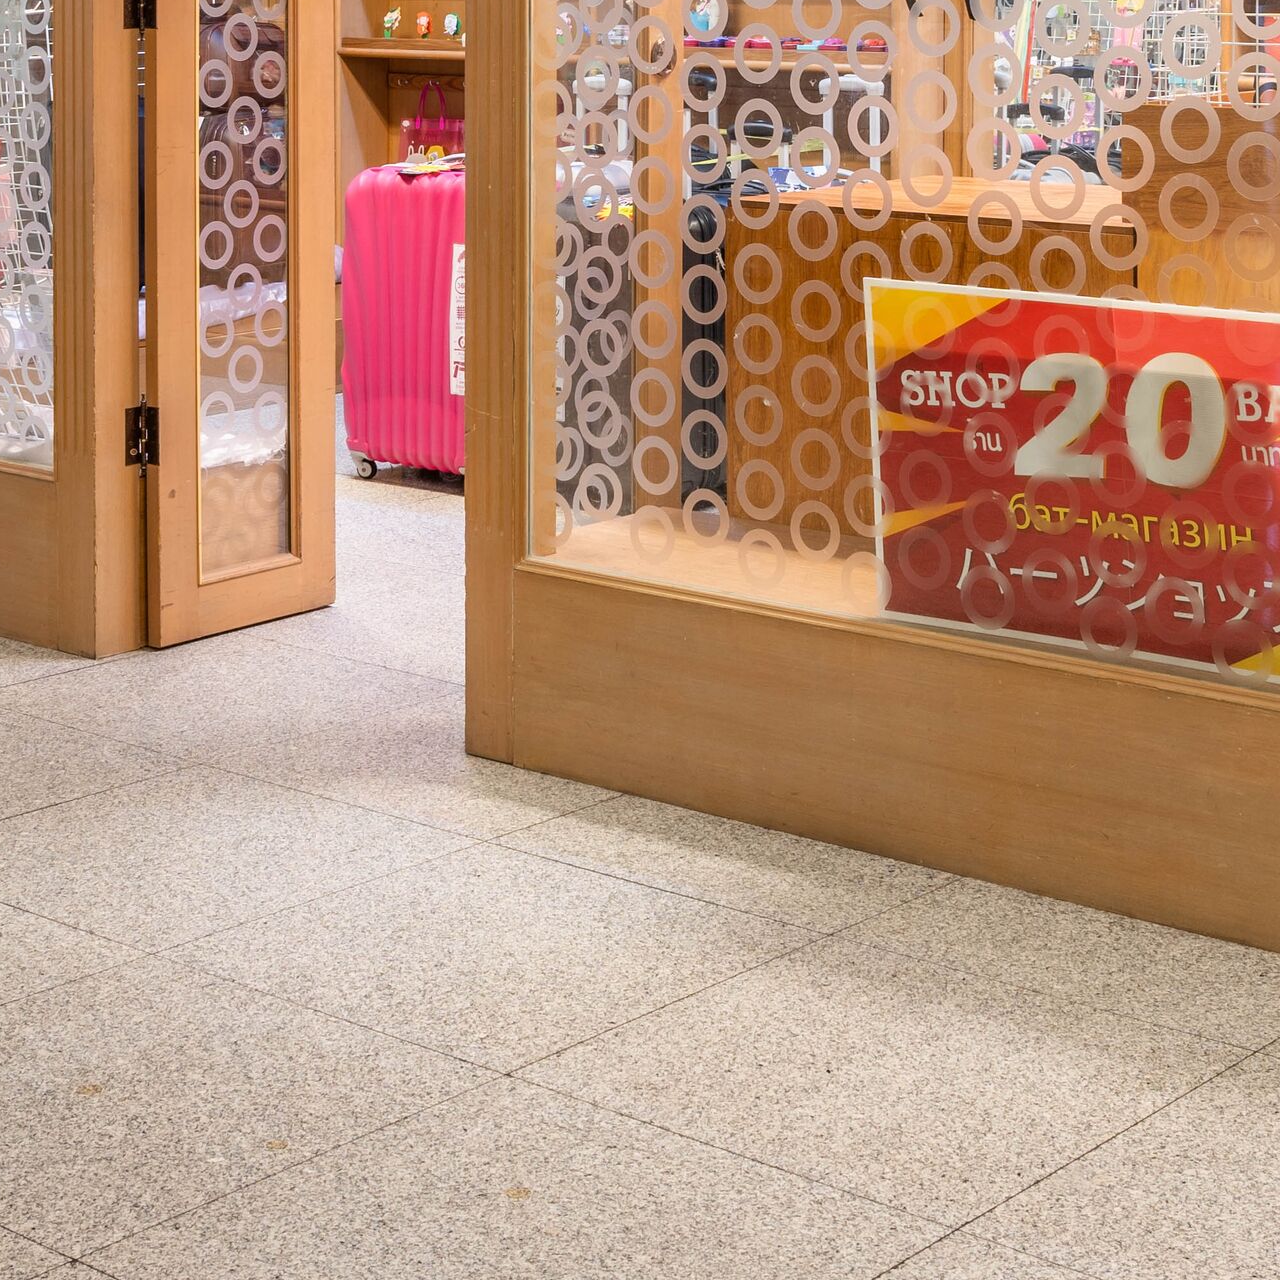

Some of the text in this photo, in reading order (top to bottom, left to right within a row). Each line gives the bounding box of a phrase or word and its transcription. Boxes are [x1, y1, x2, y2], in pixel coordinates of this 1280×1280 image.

[900, 368, 1013, 410] SHOP
[1014, 351, 1228, 491] 20
[1008, 491, 1253, 551] бат-магазин
